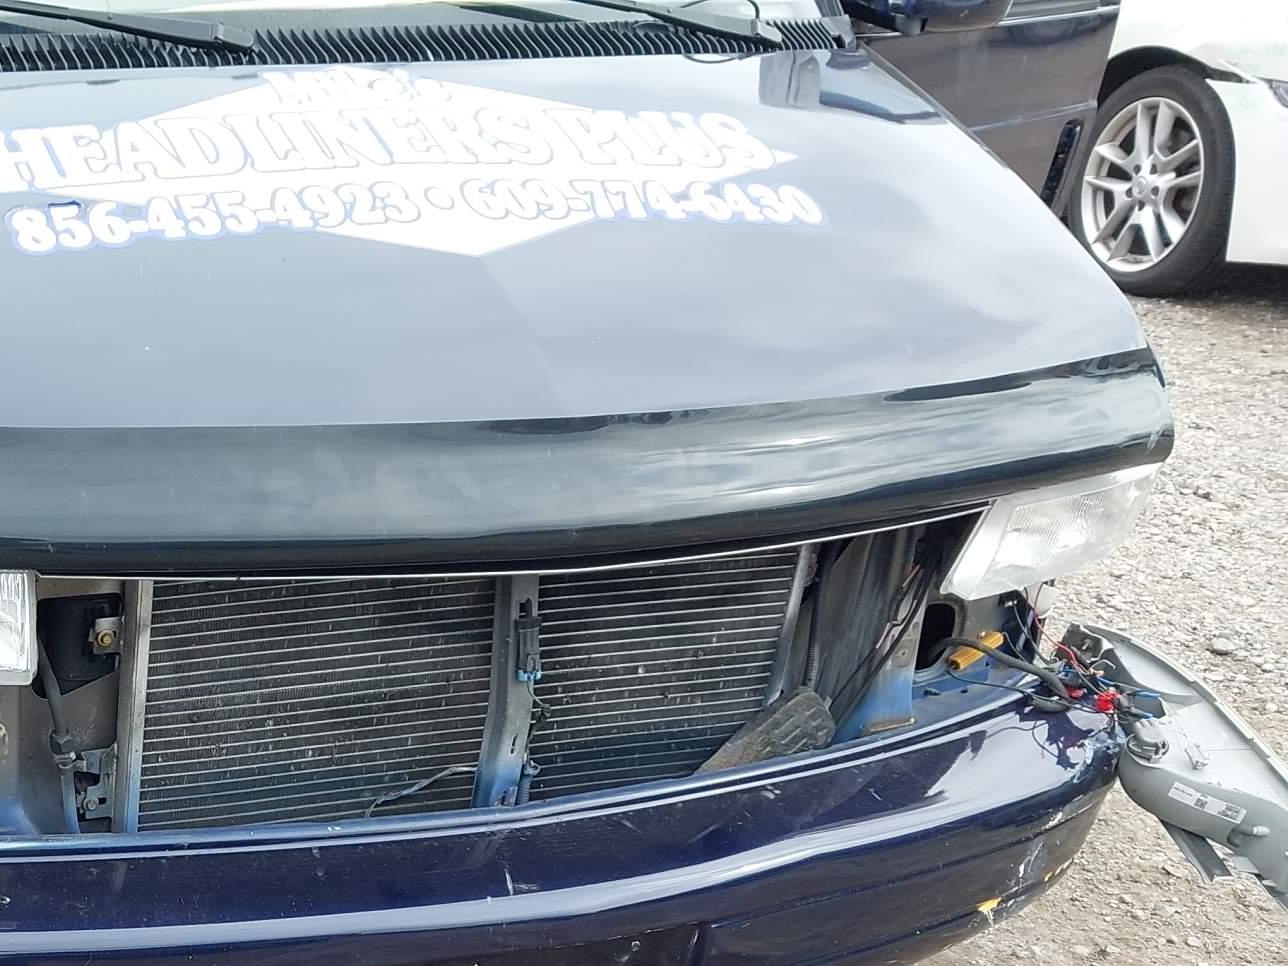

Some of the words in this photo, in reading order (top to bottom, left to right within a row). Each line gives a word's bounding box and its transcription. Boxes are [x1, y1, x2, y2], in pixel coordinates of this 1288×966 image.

[543, 108, 775, 169] PLUS
[7, 181, 420, 253] 856-455-4923
[460, 179, 825, 224] 609-774-6430
